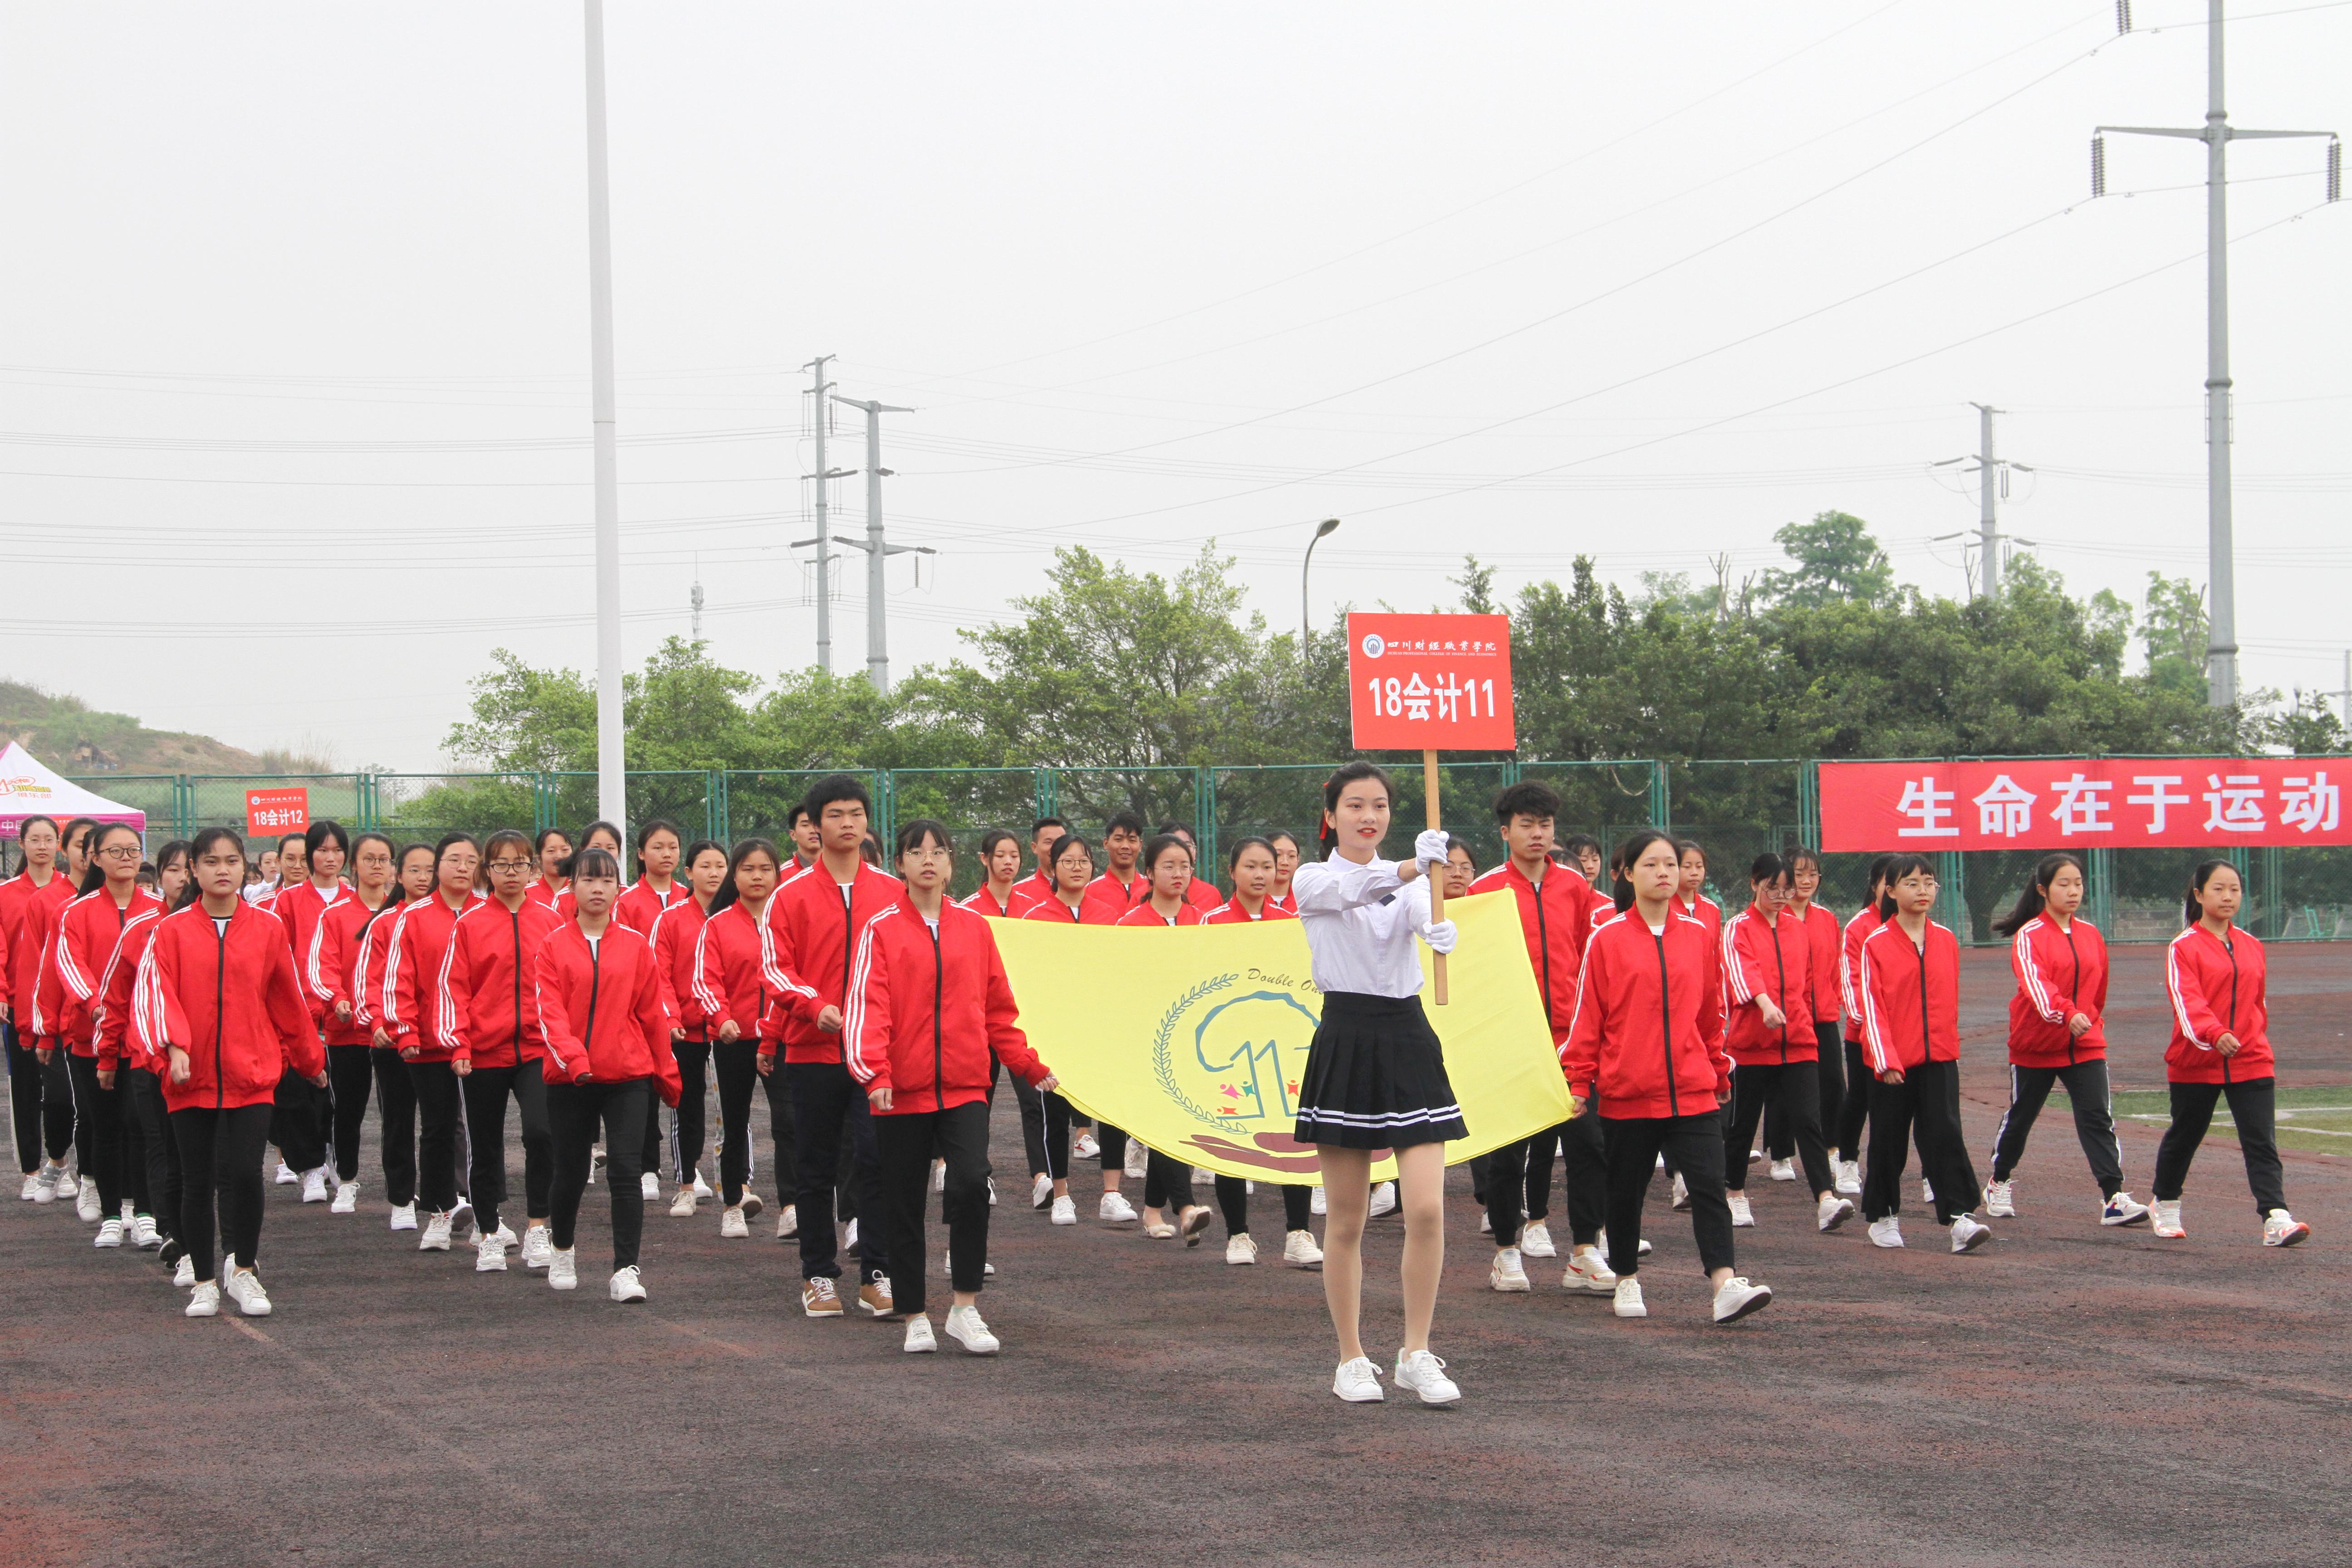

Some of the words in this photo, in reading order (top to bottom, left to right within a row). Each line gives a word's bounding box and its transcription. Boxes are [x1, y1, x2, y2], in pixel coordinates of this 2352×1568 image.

[1369, 672, 1494, 722] 18会计11
[254, 808, 303, 826] 18会计12
[1896, 772, 2340, 837] 生命在于运动
[1248, 968, 1294, 987] Double
